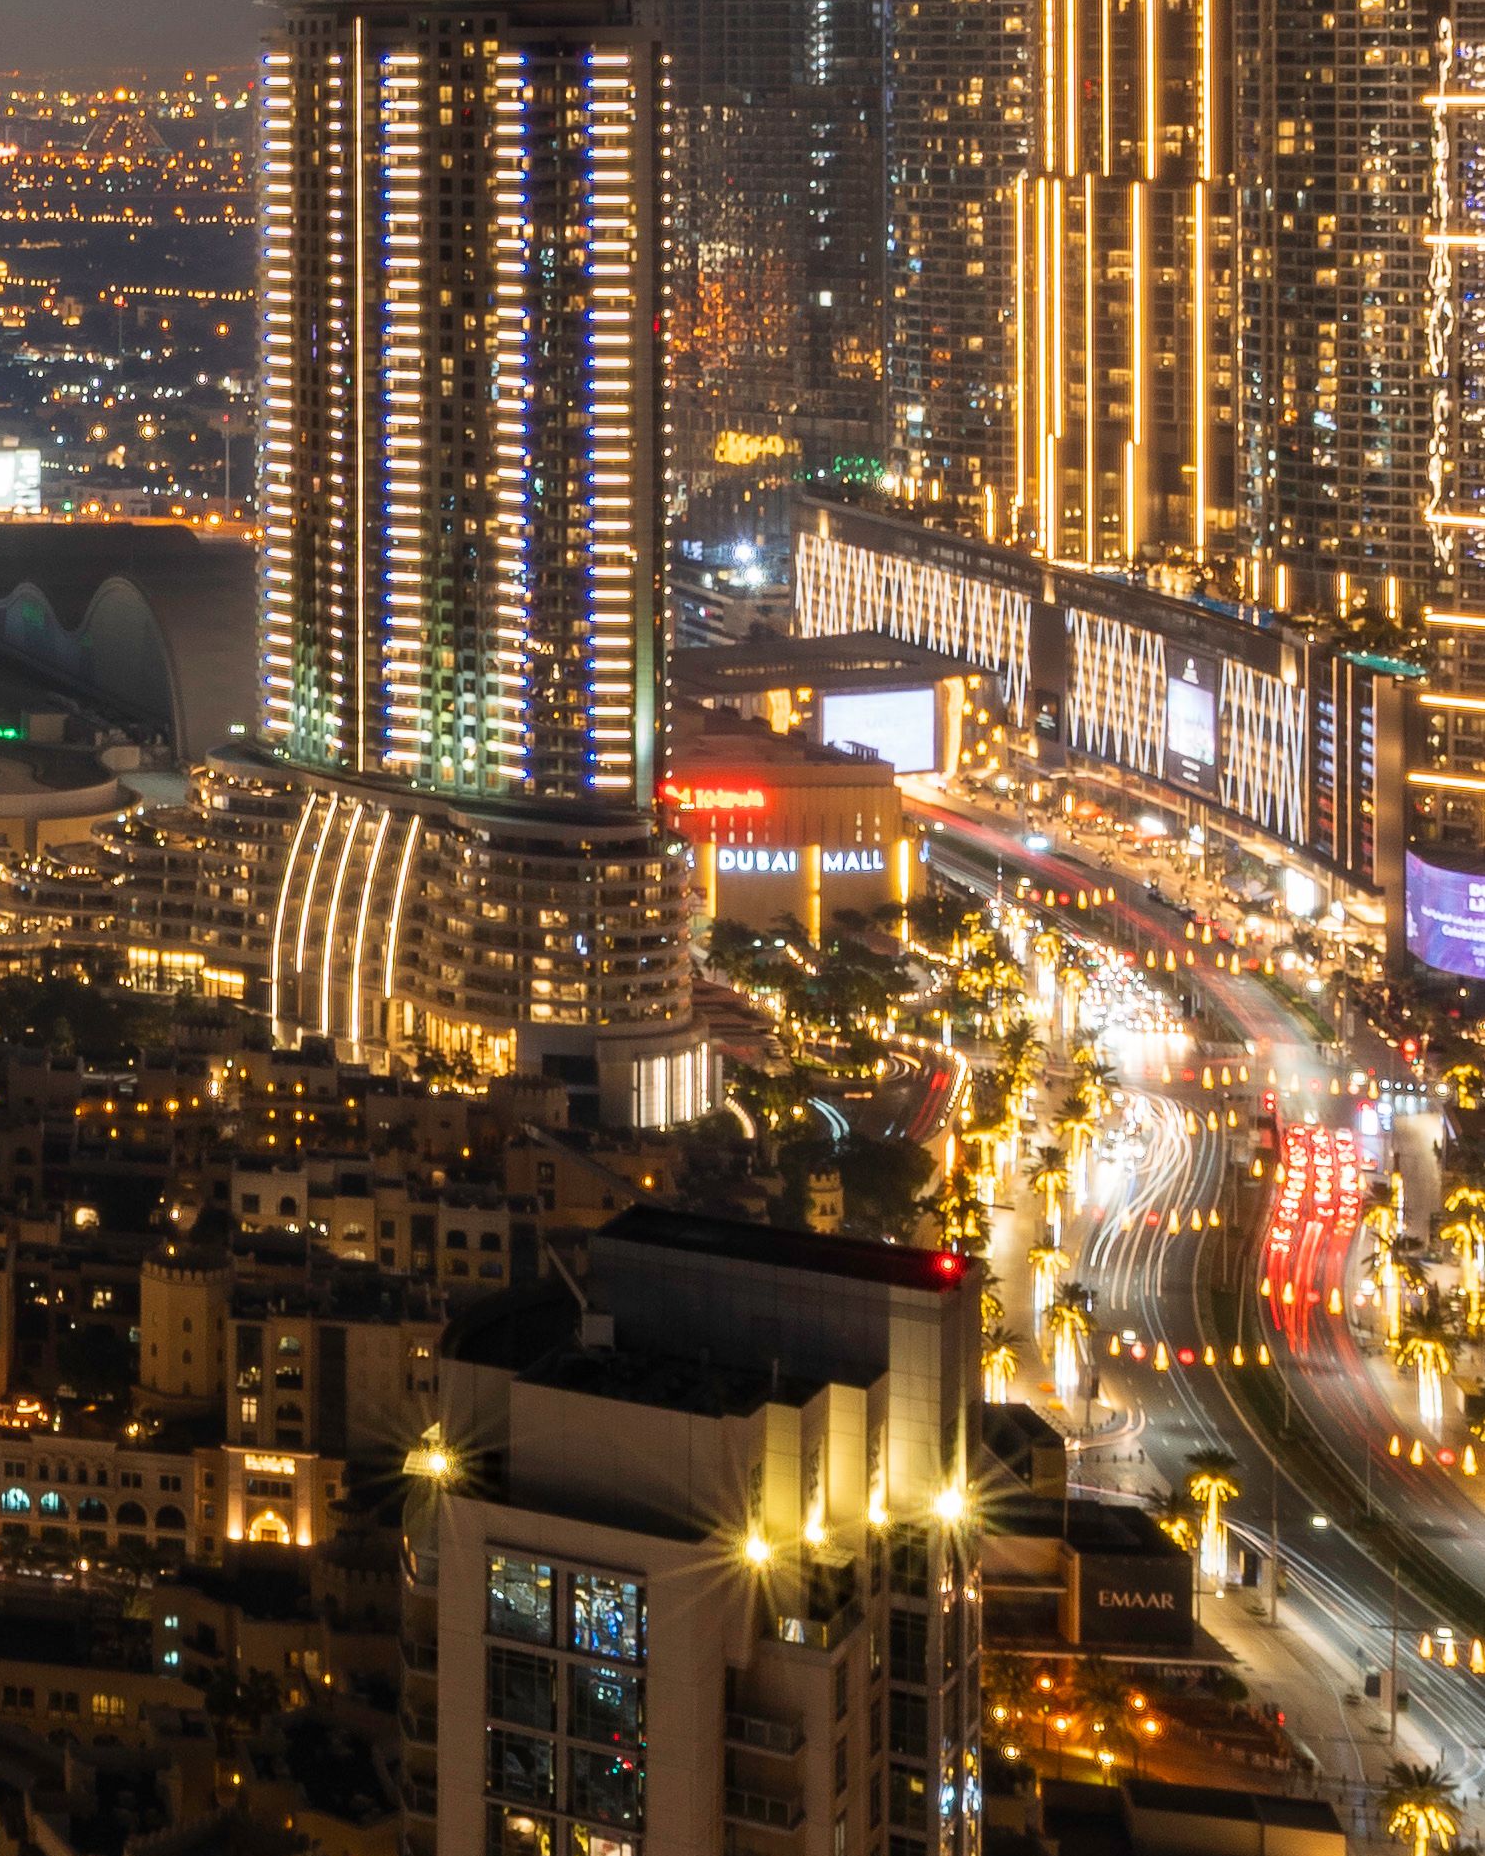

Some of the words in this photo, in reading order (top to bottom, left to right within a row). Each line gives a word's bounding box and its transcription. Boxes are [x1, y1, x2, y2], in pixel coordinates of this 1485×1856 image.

[717, 849, 799, 873] DUBAI
[821, 848, 885, 873] MALL
[1098, 1589, 1175, 1610] EMAAR
